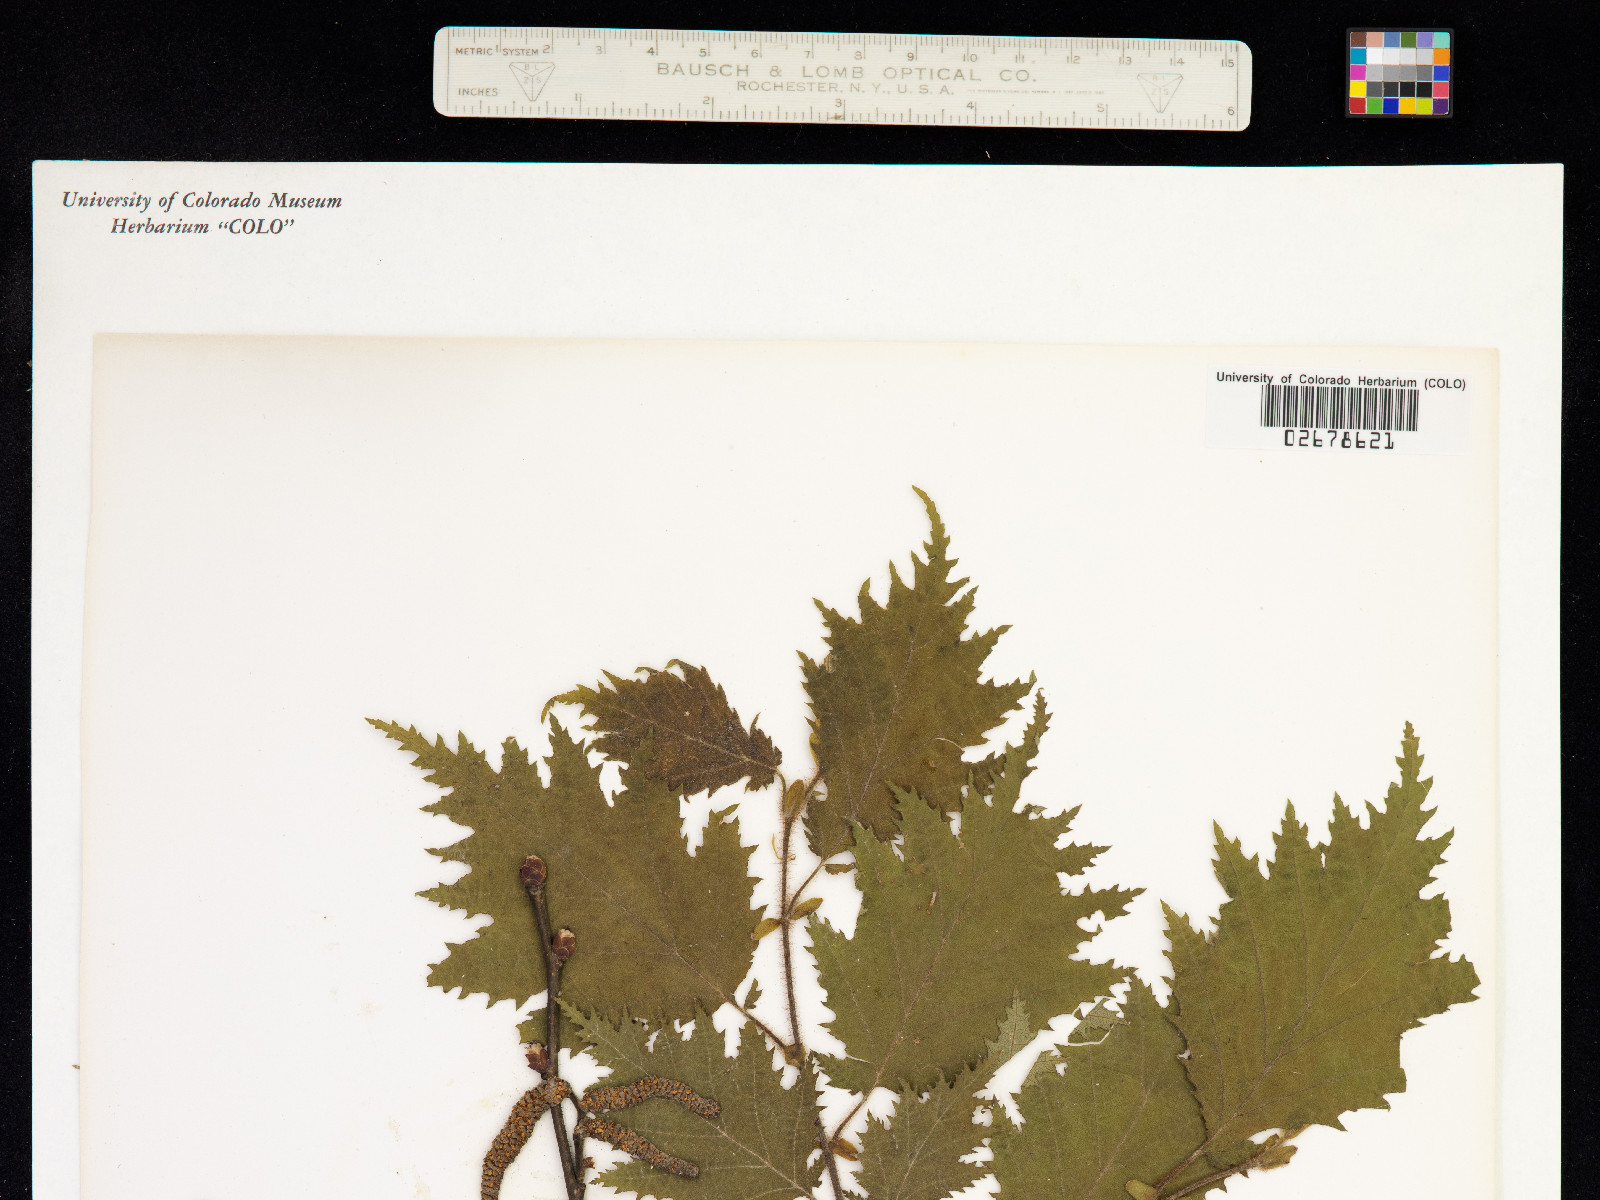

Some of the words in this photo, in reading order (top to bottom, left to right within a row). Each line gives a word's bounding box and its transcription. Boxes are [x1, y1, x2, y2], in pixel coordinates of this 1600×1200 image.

[503, 48, 538, 56] SYSTEM
[543, 45, 550, 53] 2
[596, 46, 602, 54] 3
[647, 47, 655, 56] 4
[699, 48, 707, 57] 5
[751, 49, 758, 58] 6
[805, 51, 811, 59] 7
[855, 51, 863, 60] 8
[907, 52, 914, 61] 9
[657, 63, 749, 76] BAUSCH
[769, 65, 782, 77] &
[803, 65, 864, 79] LOMB
[883, 67, 981, 81] OPTICAL
[1000, 69, 1036, 82] CO.
[458, 88, 498, 96] INCHES
[850, 83, 865, 93] N.
[898, 84, 914, 94] U.
[919, 84, 934, 94] S.
[939, 85, 954, 95] A.
[703, 96, 710, 105] 2
[835, 99, 842, 107] 3
[966, 101, 974, 110] 4
[1097, 103, 1104, 112] 5
[1228, 106, 1234, 115] 6
[62, 191, 151, 212] University
[159, 191, 178, 212] of
[182, 192, 261, 208] Colorado
[268, 193, 342, 209] Museum
[111, 217, 209, 234] Herbarium
[1216, 372, 1273, 385] University
[1281, 374, 1292, 383] of
[1300, 375, 1351, 385] Colorado
[1359, 376, 1417, 387] Herbarium
[1424, 378, 1466, 390] (COLO)
[1284, 430, 1394, 450] 02678621
